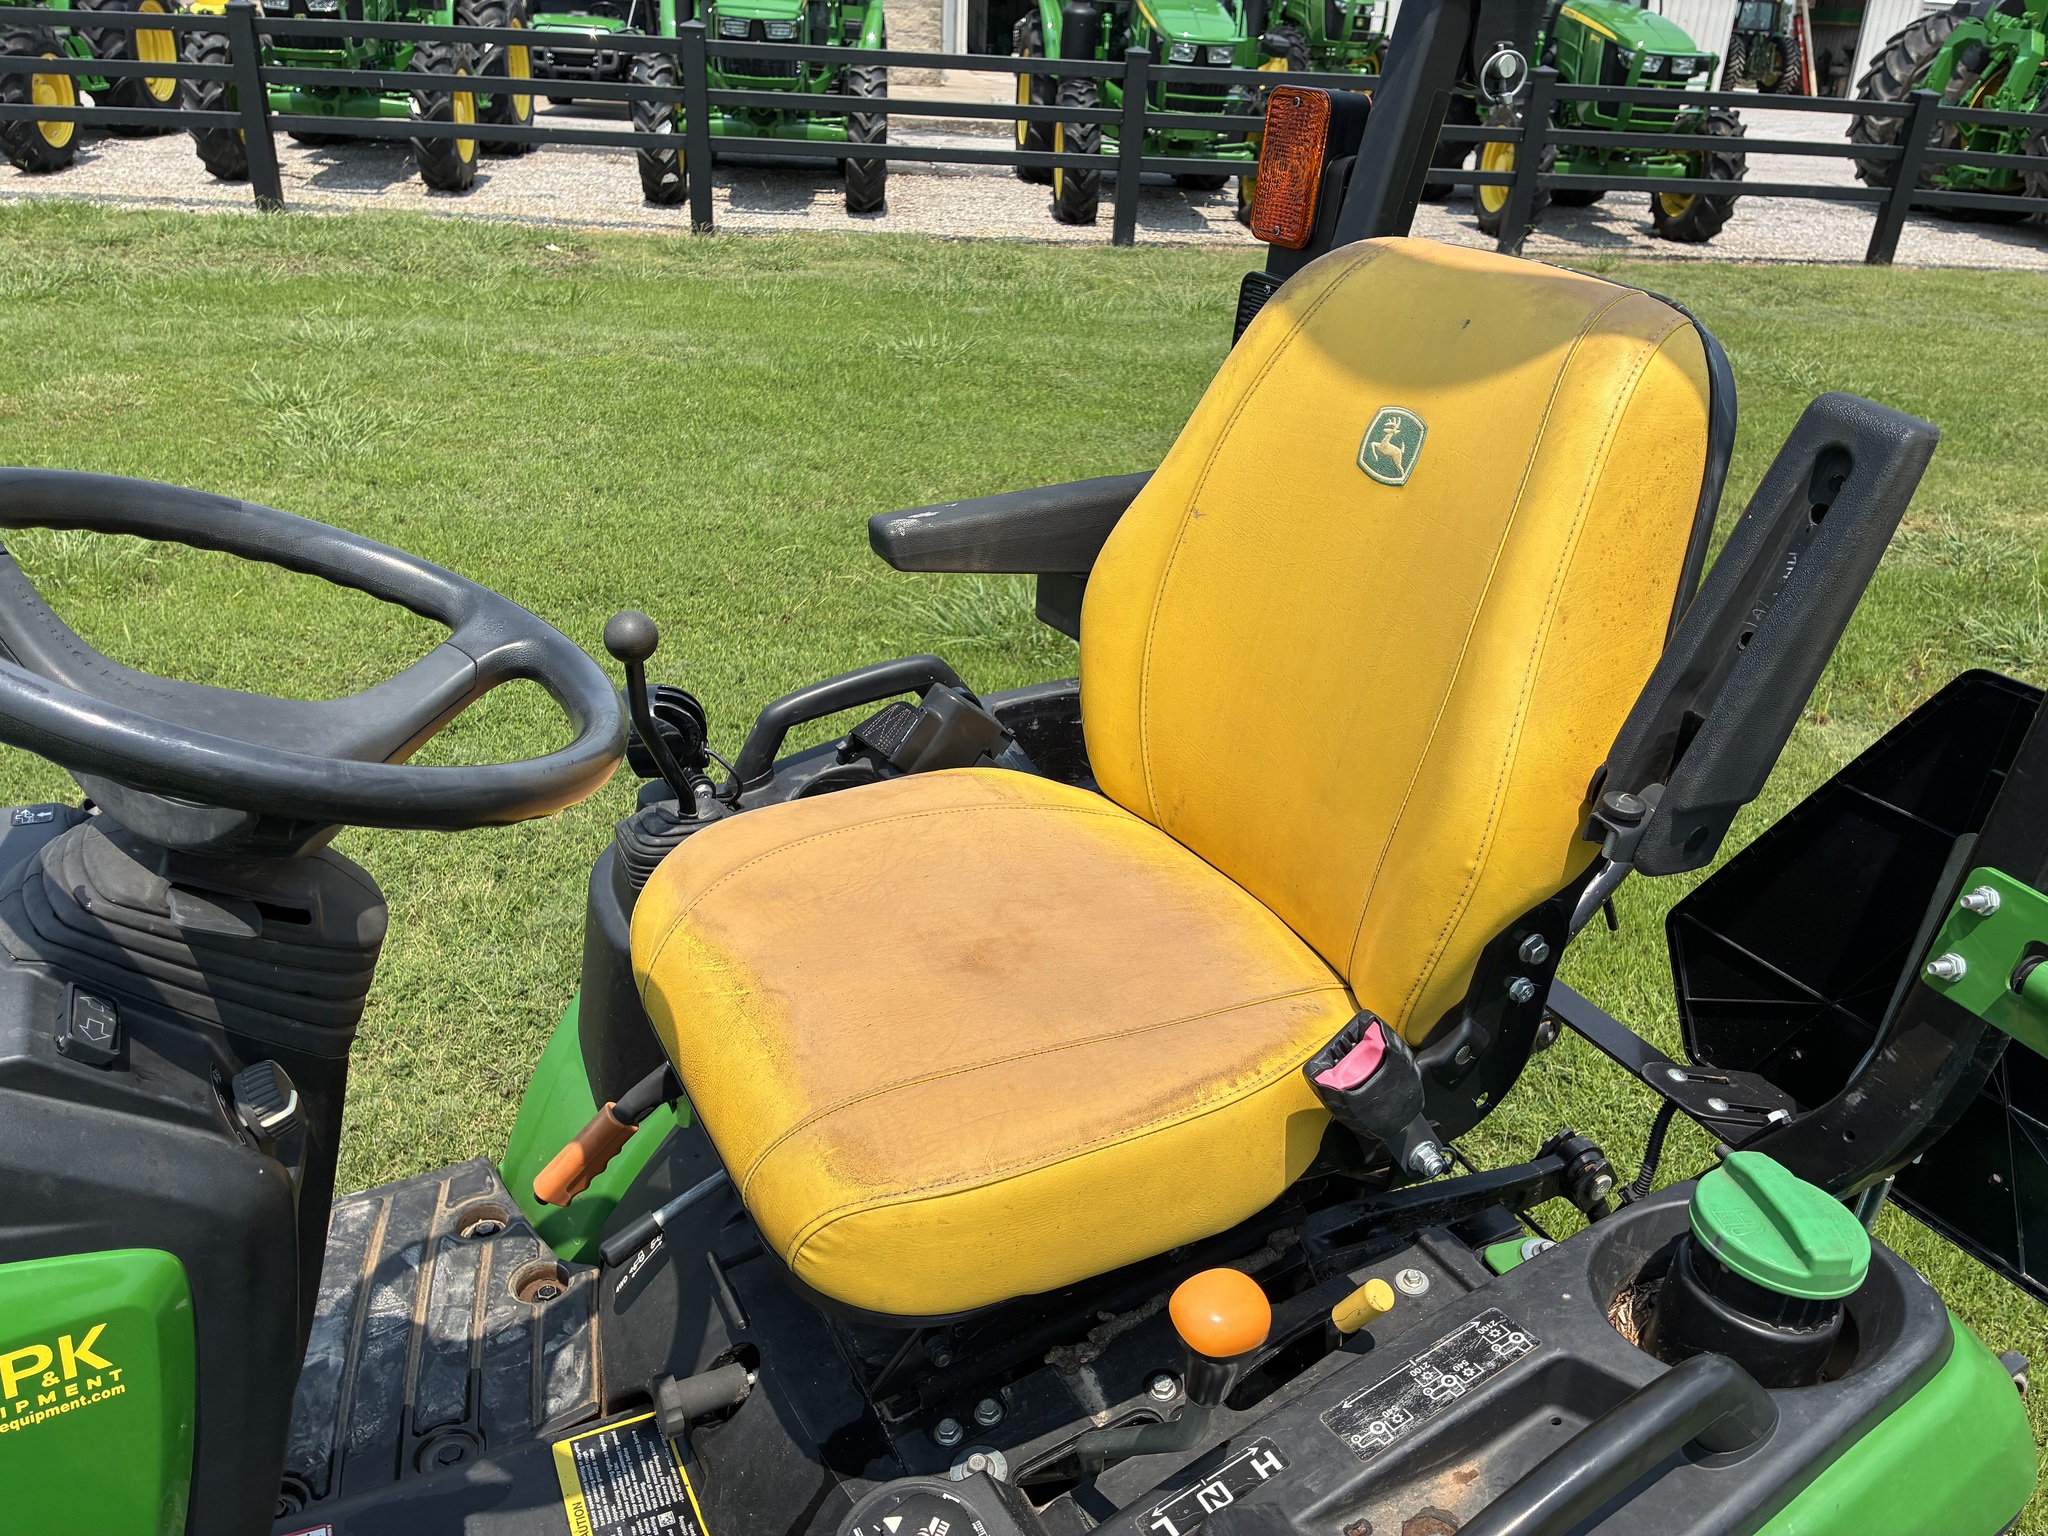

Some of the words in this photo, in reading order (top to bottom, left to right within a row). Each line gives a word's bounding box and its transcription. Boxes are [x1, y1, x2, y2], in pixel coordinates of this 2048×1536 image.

[616, 1275, 628, 1294] 4WD
[1477, 1320, 1498, 1335] 2100
[1409, 1361, 1431, 1377] 2100
[1452, 1358, 1470, 1372] 540
[1382, 1404, 1400, 1418] 540
[1250, 1450, 1283, 1480] H
[1200, 1484, 1230, 1510] N
[1150, 1516, 1180, 1536] L
